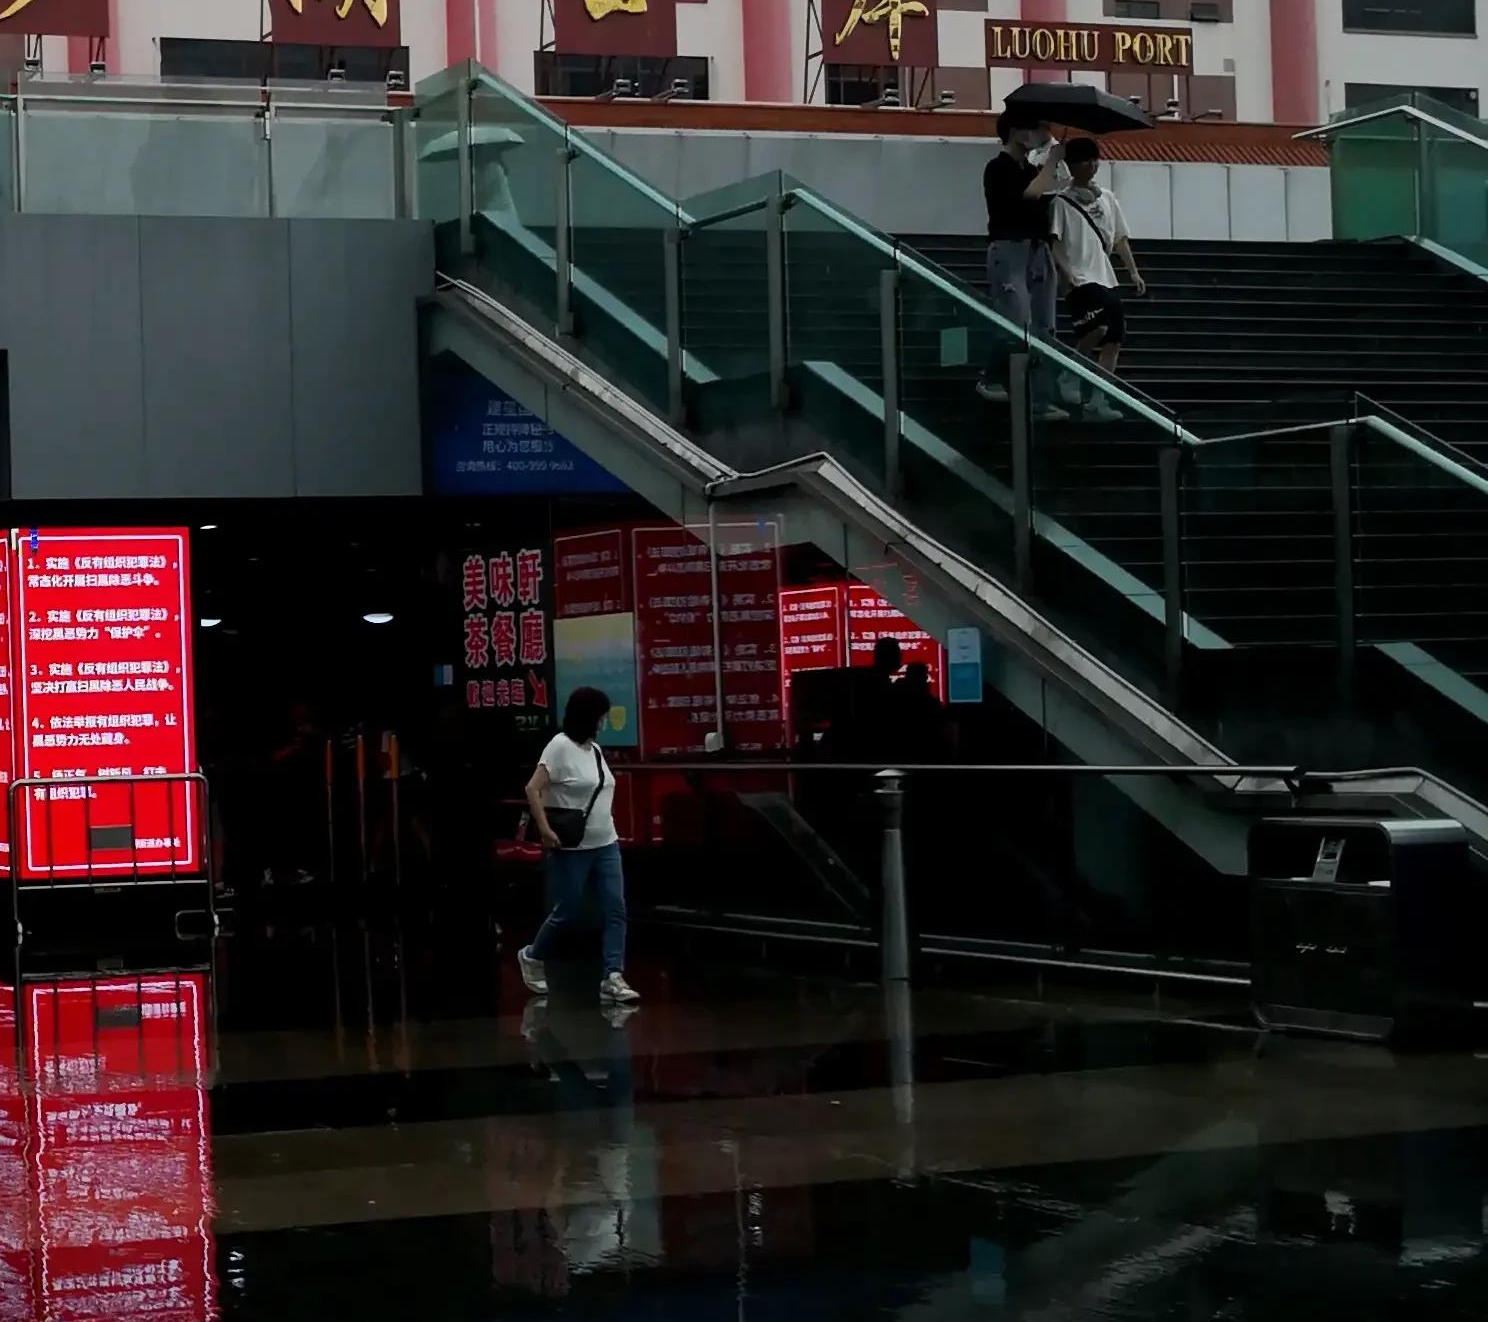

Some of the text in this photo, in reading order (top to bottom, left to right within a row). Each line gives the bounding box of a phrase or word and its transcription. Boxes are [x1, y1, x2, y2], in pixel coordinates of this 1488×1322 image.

[991, 26, 1192, 66] LUOHU PORT
[463, 548, 544, 612] 美味軒
[464, 608, 547, 668] 茶餐廳
